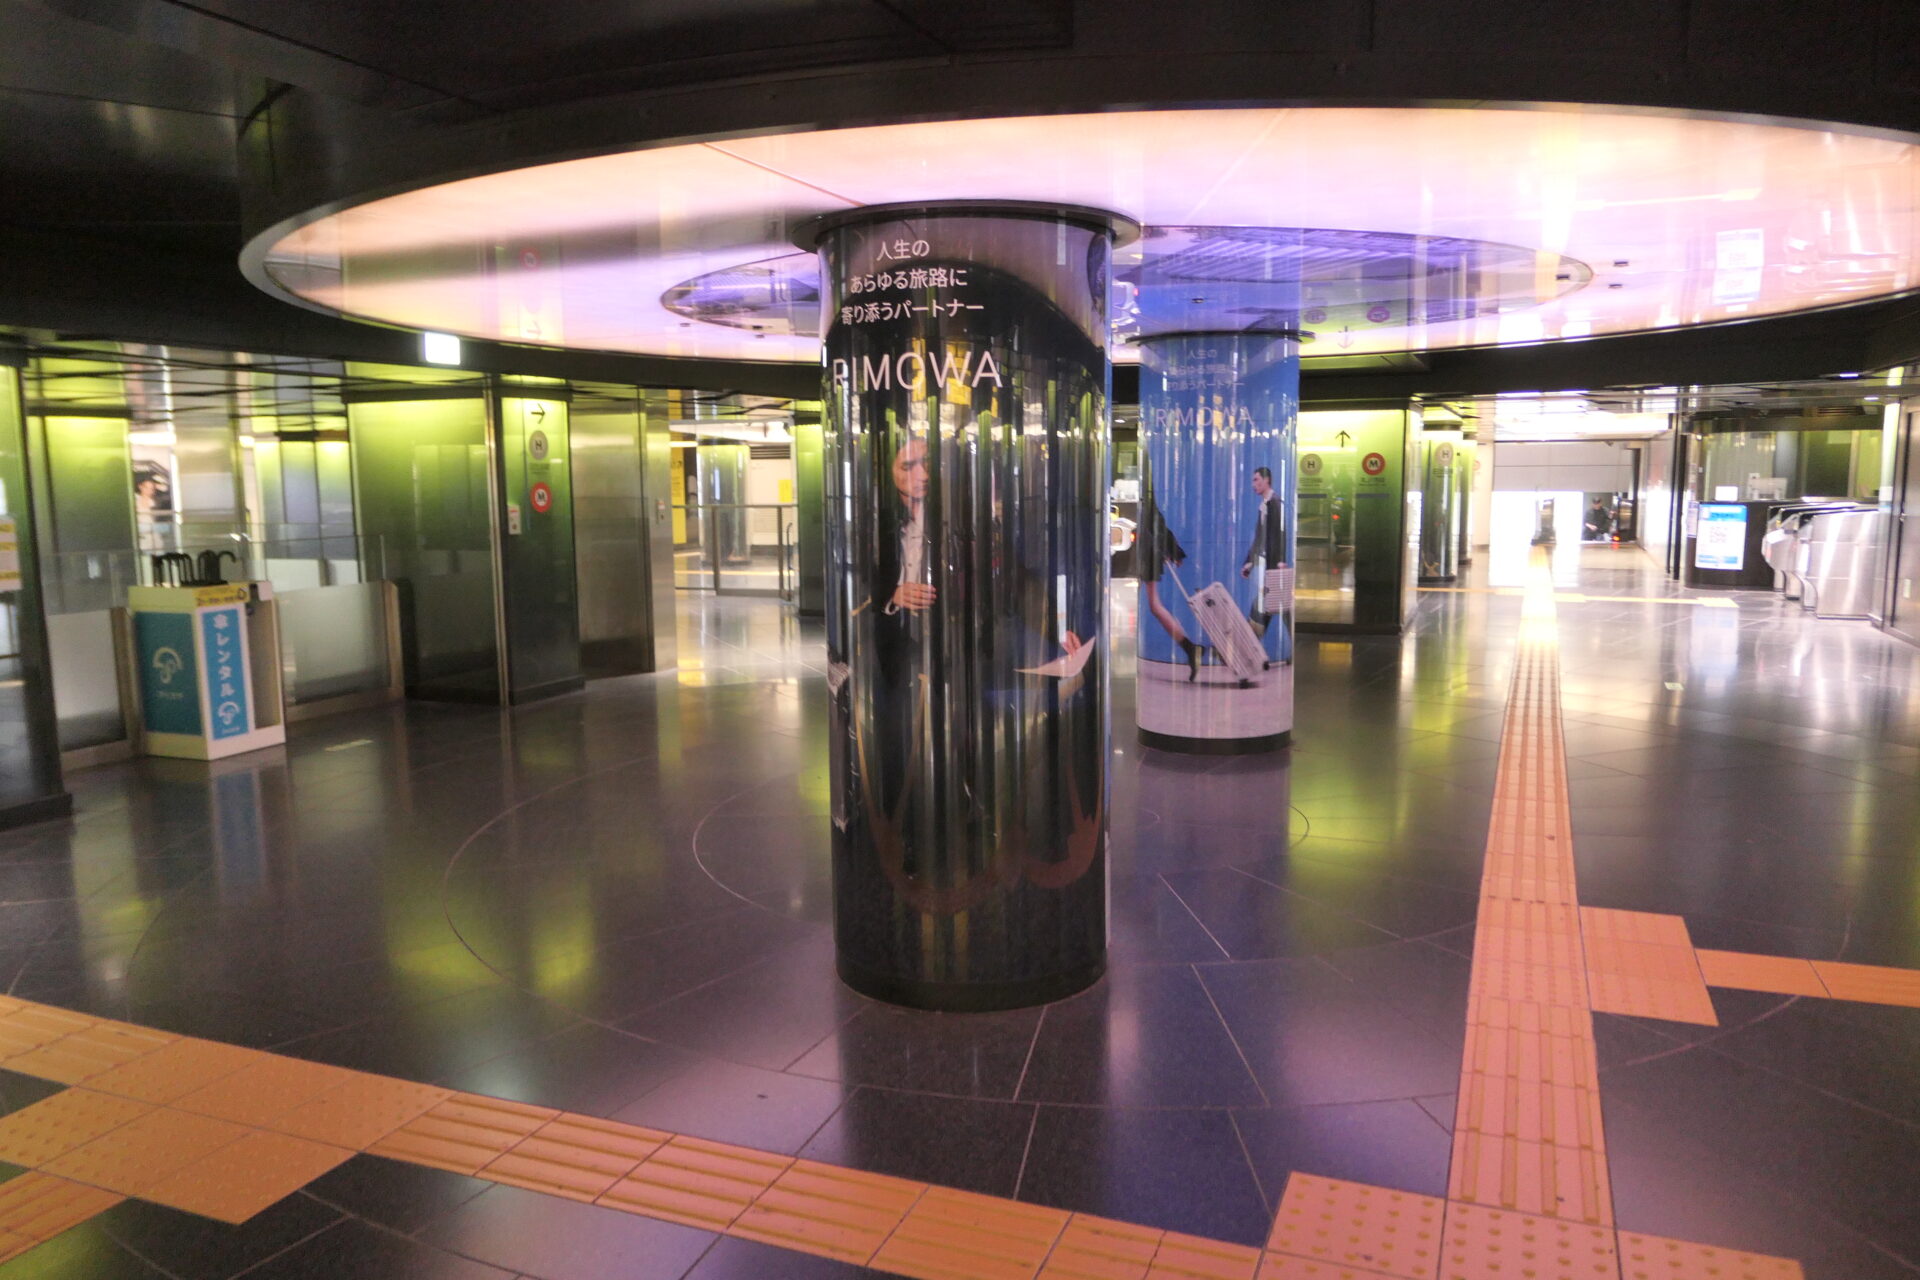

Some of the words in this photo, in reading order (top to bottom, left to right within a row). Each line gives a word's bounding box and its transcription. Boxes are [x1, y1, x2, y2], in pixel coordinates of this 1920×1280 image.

[876, 239, 930, 261] 人生の
[850, 267, 968, 294] あらゆる旅路に
[841, 299, 984, 325] 寄り添うパートナー
[833, 351, 1003, 393] RIMOWA
[1156, 406, 1255, 427] RMOWA
[1306, 459, 1316, 470] H
[1368, 459, 1379, 468] M
